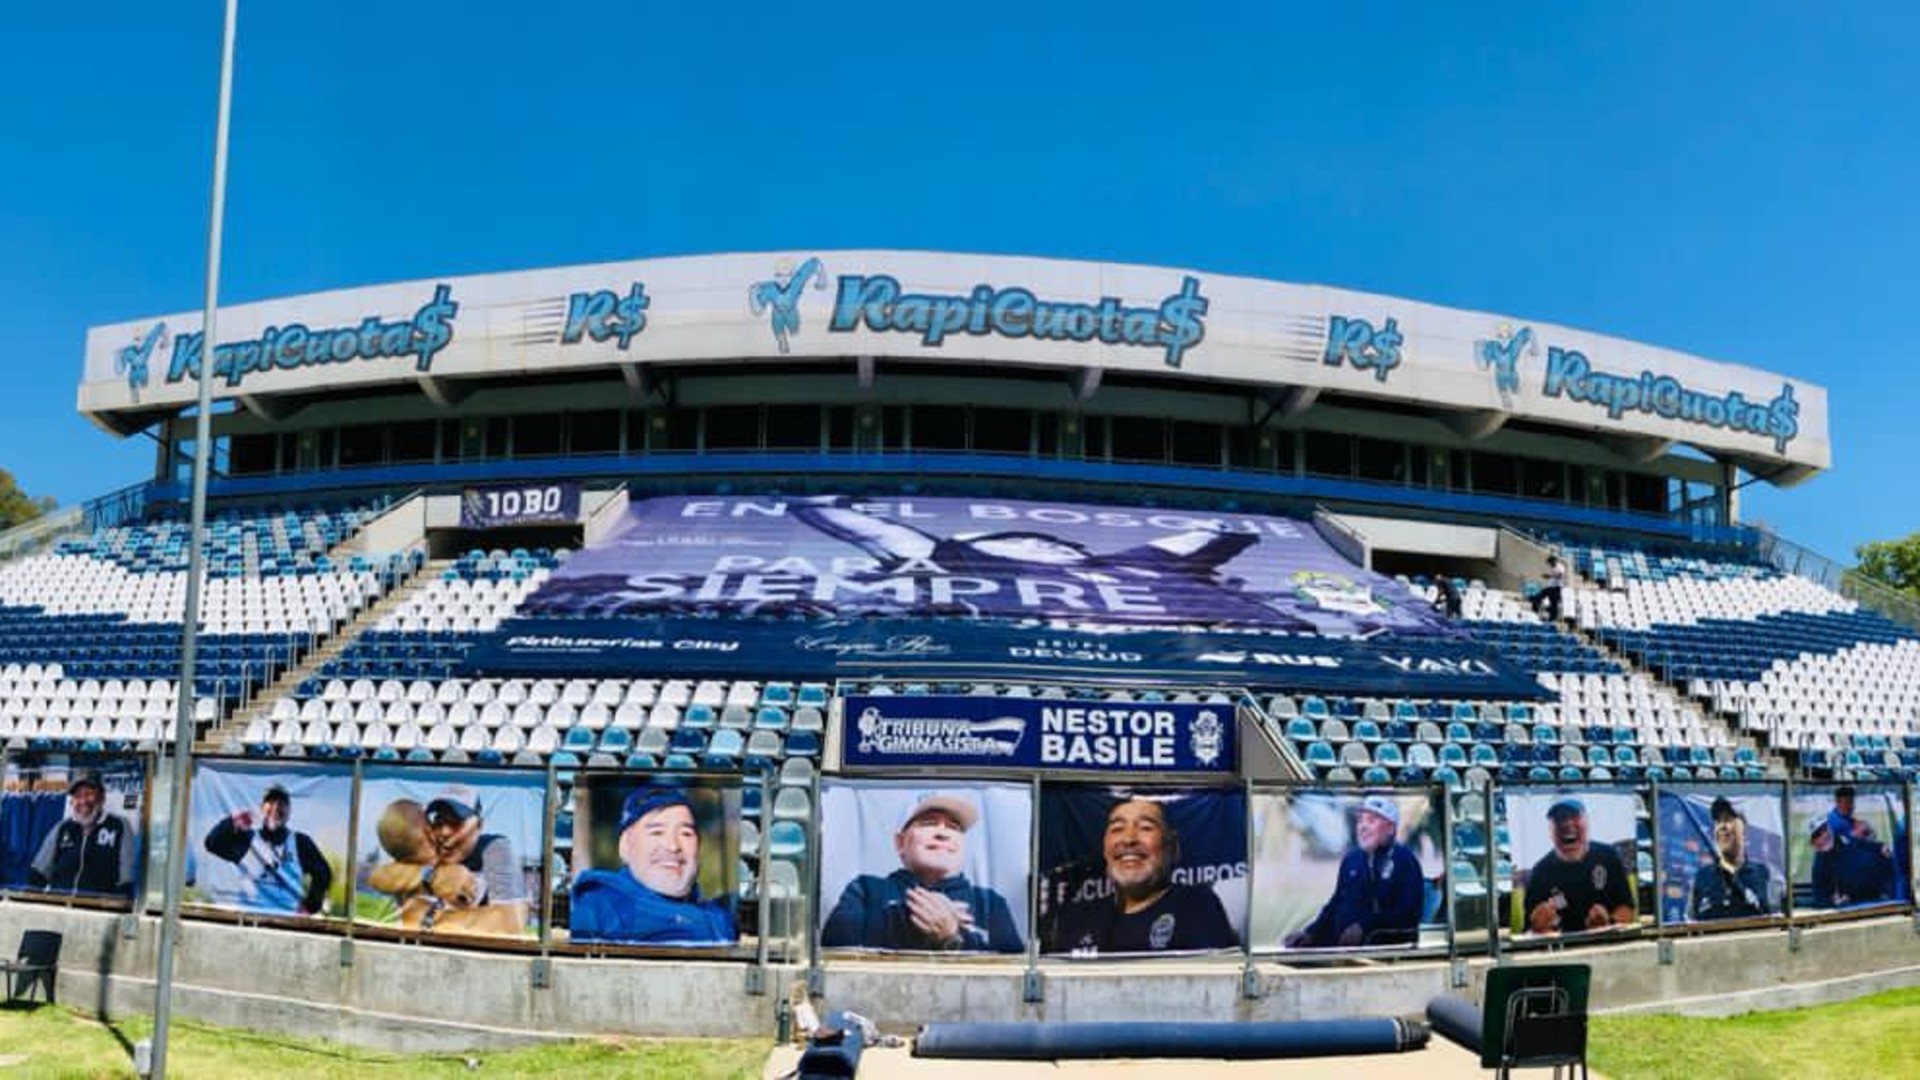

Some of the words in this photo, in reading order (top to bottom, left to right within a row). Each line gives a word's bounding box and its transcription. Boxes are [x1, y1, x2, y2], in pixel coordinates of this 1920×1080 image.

[560, 281, 650, 351] R$
[1324, 314, 1403, 382] R$
[681, 501, 788, 517] EN
[614, 573, 1167, 614] SIEMPRE
[1009, 647, 1143, 662] DELSUD
[880, 719, 972, 736] TRIBUNA
[1041, 707, 1176, 736] NESTOR
[1040, 734, 1176, 766] BASILE
